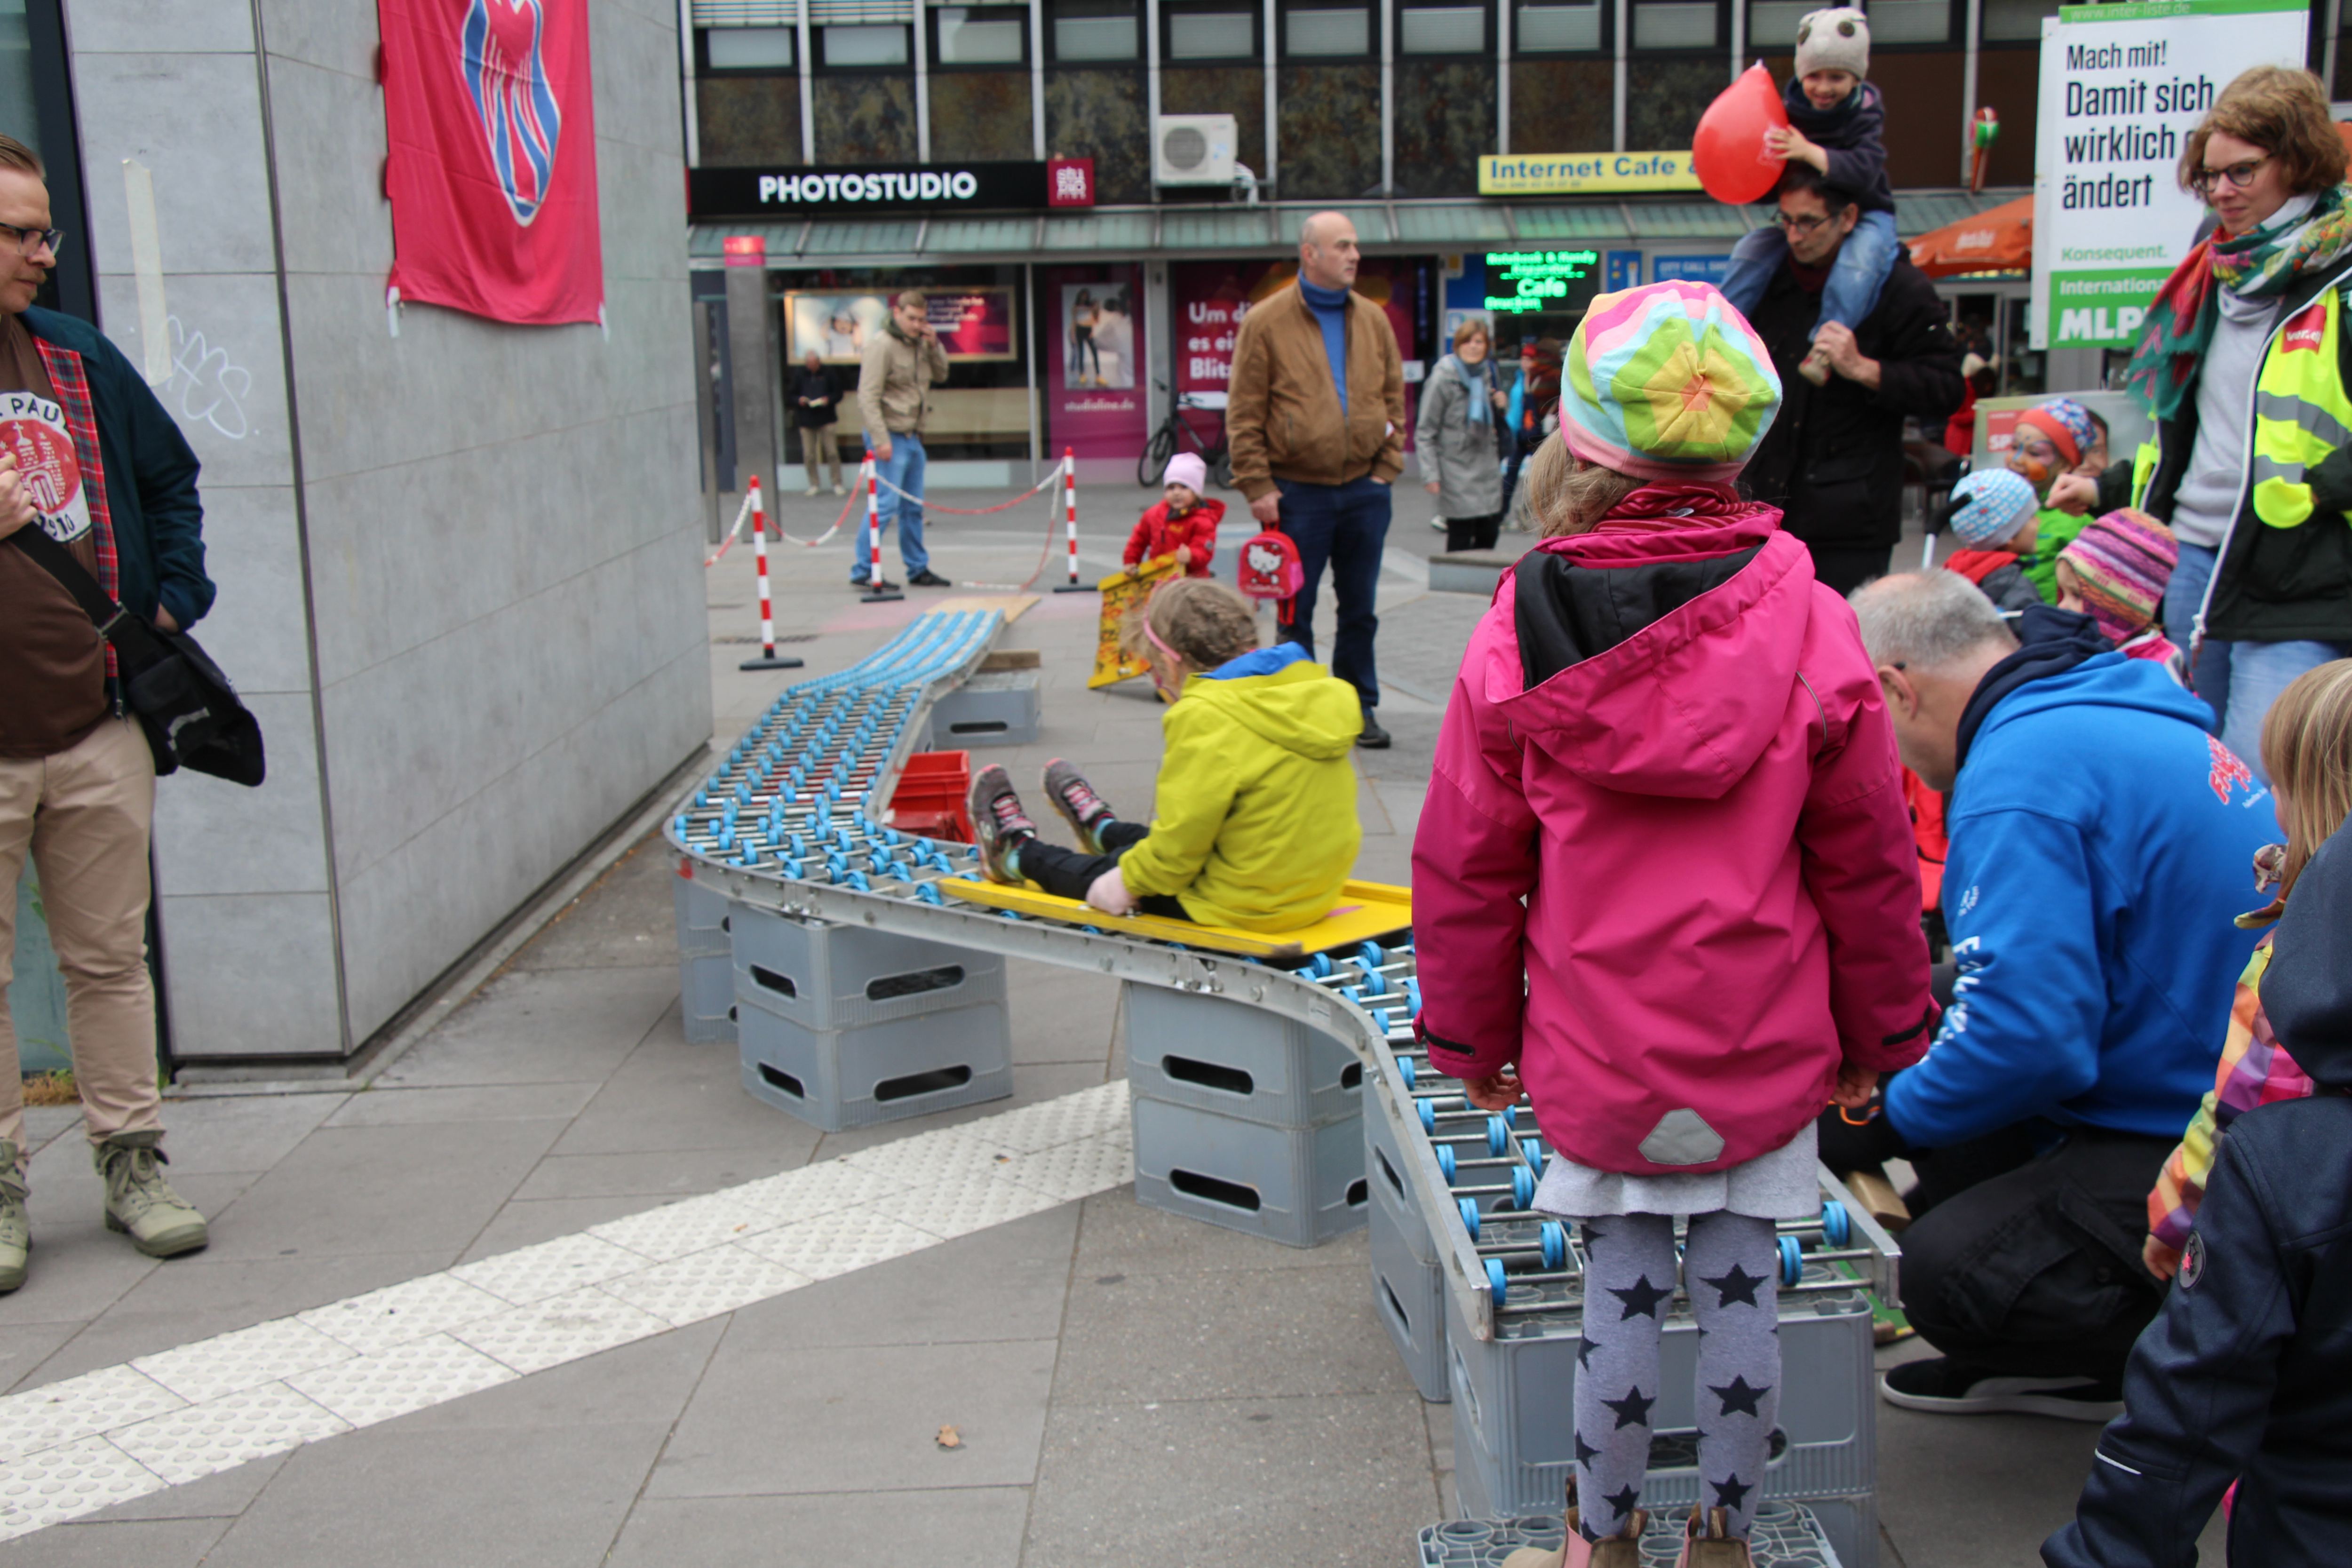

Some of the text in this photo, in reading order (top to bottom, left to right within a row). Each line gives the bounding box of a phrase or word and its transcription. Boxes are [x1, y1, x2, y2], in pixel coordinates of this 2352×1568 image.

[2071, 2, 2190, 19] www.inter-liste.de
[2067, 40, 2166, 70] Mach mit!
[2066, 74, 2214, 117] Damit sich
[2065, 123, 2175, 163] wirklich
[1492, 158, 1603, 178] Internet
[1614, 155, 1676, 175] Cafe
[759, 172, 977, 202] PHOTOSTUDIO
[2063, 172, 2153, 210] ändert
[2061, 245, 2167, 262] Konsequent.
[1517, 277, 1567, 297] Cafe
[1189, 302, 1227, 324] Um
[2058, 306, 2151, 341] MLP
[1188, 330, 1235, 351] es ei
[1989, 434, 2018, 450] SP
